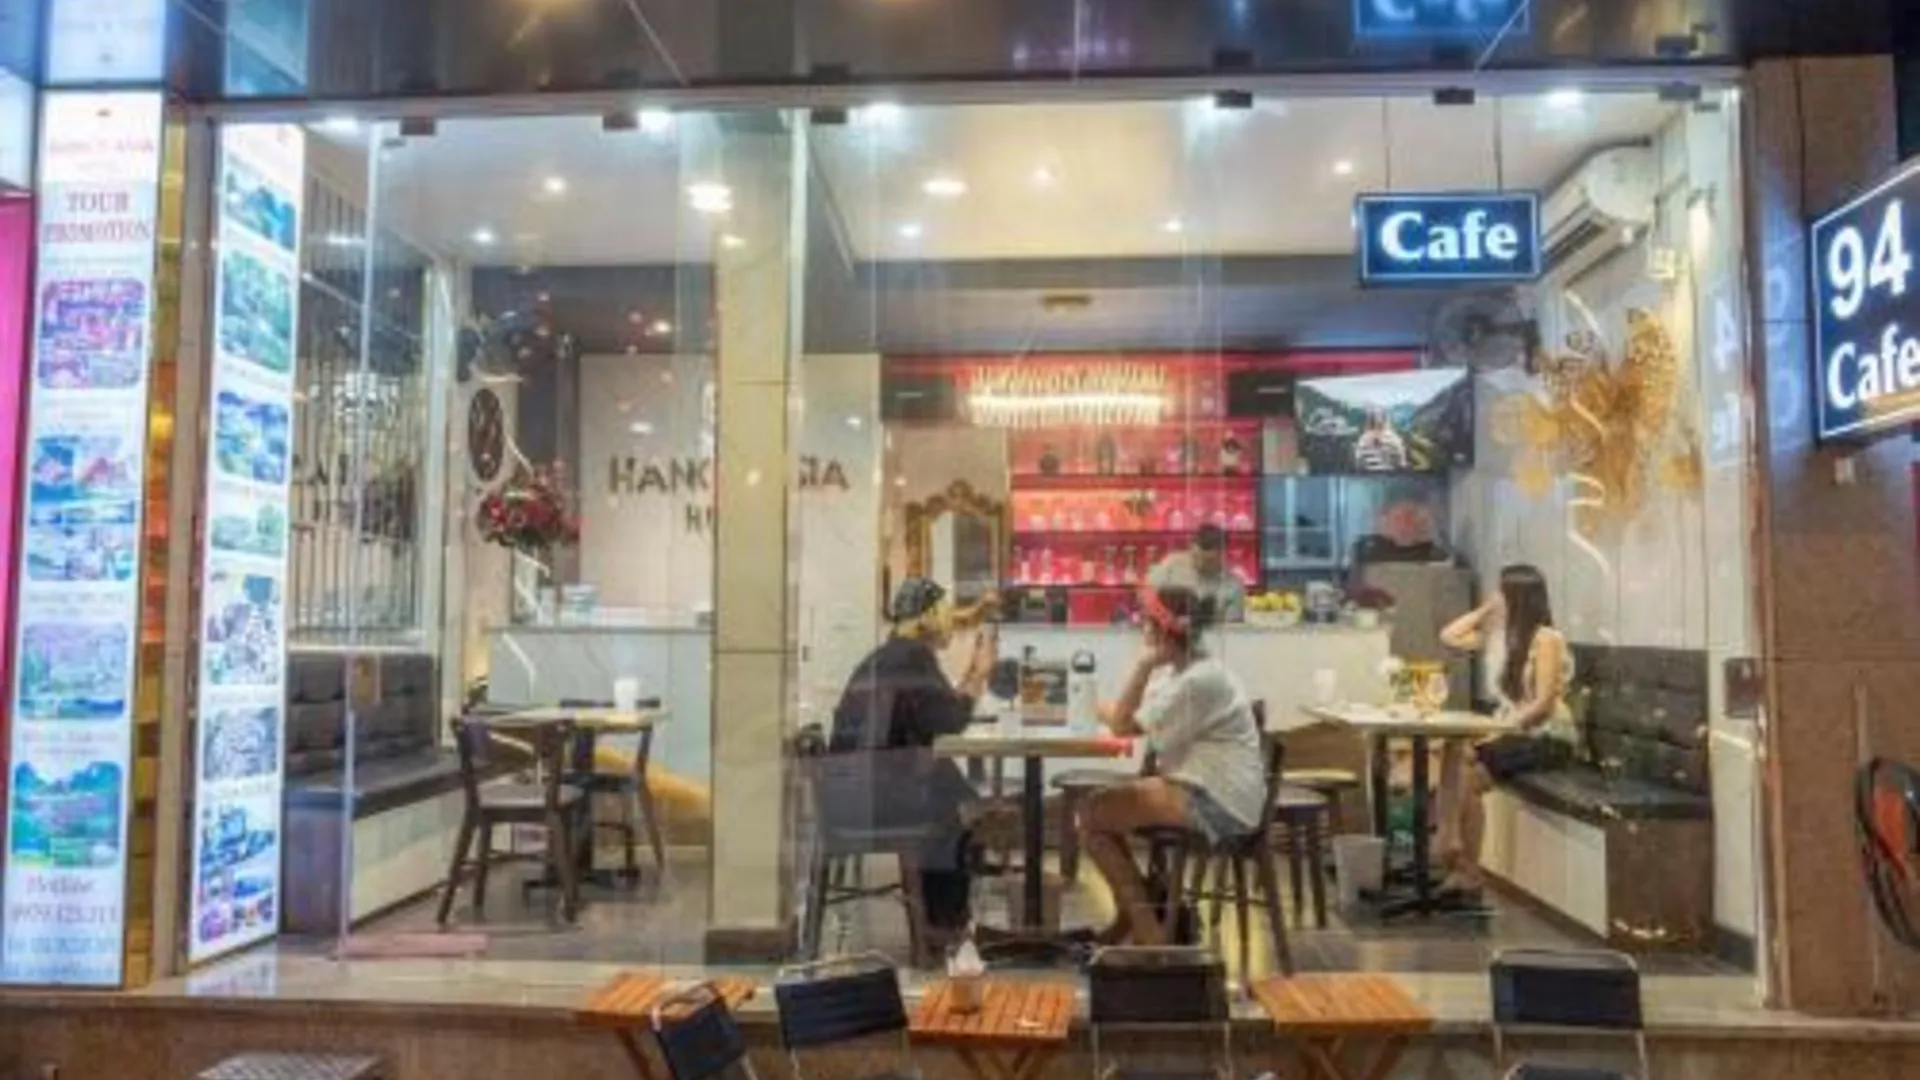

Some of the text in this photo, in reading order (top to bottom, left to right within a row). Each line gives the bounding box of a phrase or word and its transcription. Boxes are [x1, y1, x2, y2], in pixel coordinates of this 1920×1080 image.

[66, 191, 129, 213] TOUR
[43, 219, 151, 244] PROMOTION
[1381, 210, 1519, 260] Cafe
[1829, 200, 1912, 319] 94
[1828, 324, 1920, 409] Cafe
